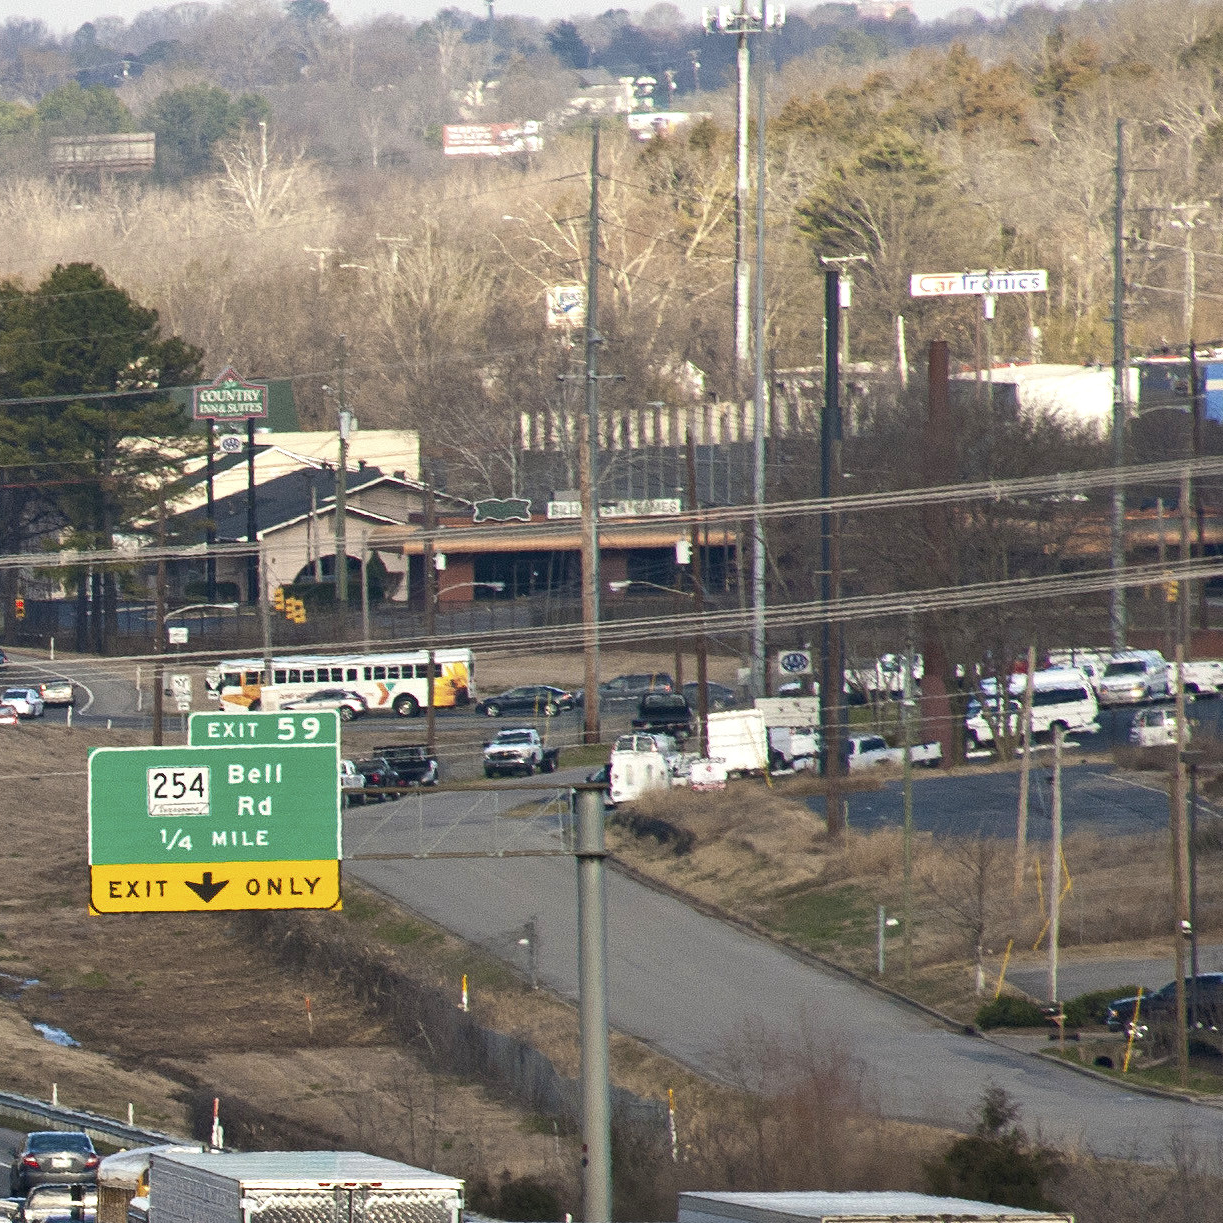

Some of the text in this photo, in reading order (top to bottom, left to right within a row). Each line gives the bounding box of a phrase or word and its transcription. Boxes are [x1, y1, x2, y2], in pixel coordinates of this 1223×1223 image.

[199, 390, 260, 402] COUNTRY
[227, 402, 263, 413] SUITES
[207, 717, 320, 740] EXIT 59
[153, 764, 282, 799] 254 Bell
[238, 796, 272, 816] Rd
[160, 829, 269, 851] 1/4 MILE
[109, 877, 321, 899] EXIT ONLY
